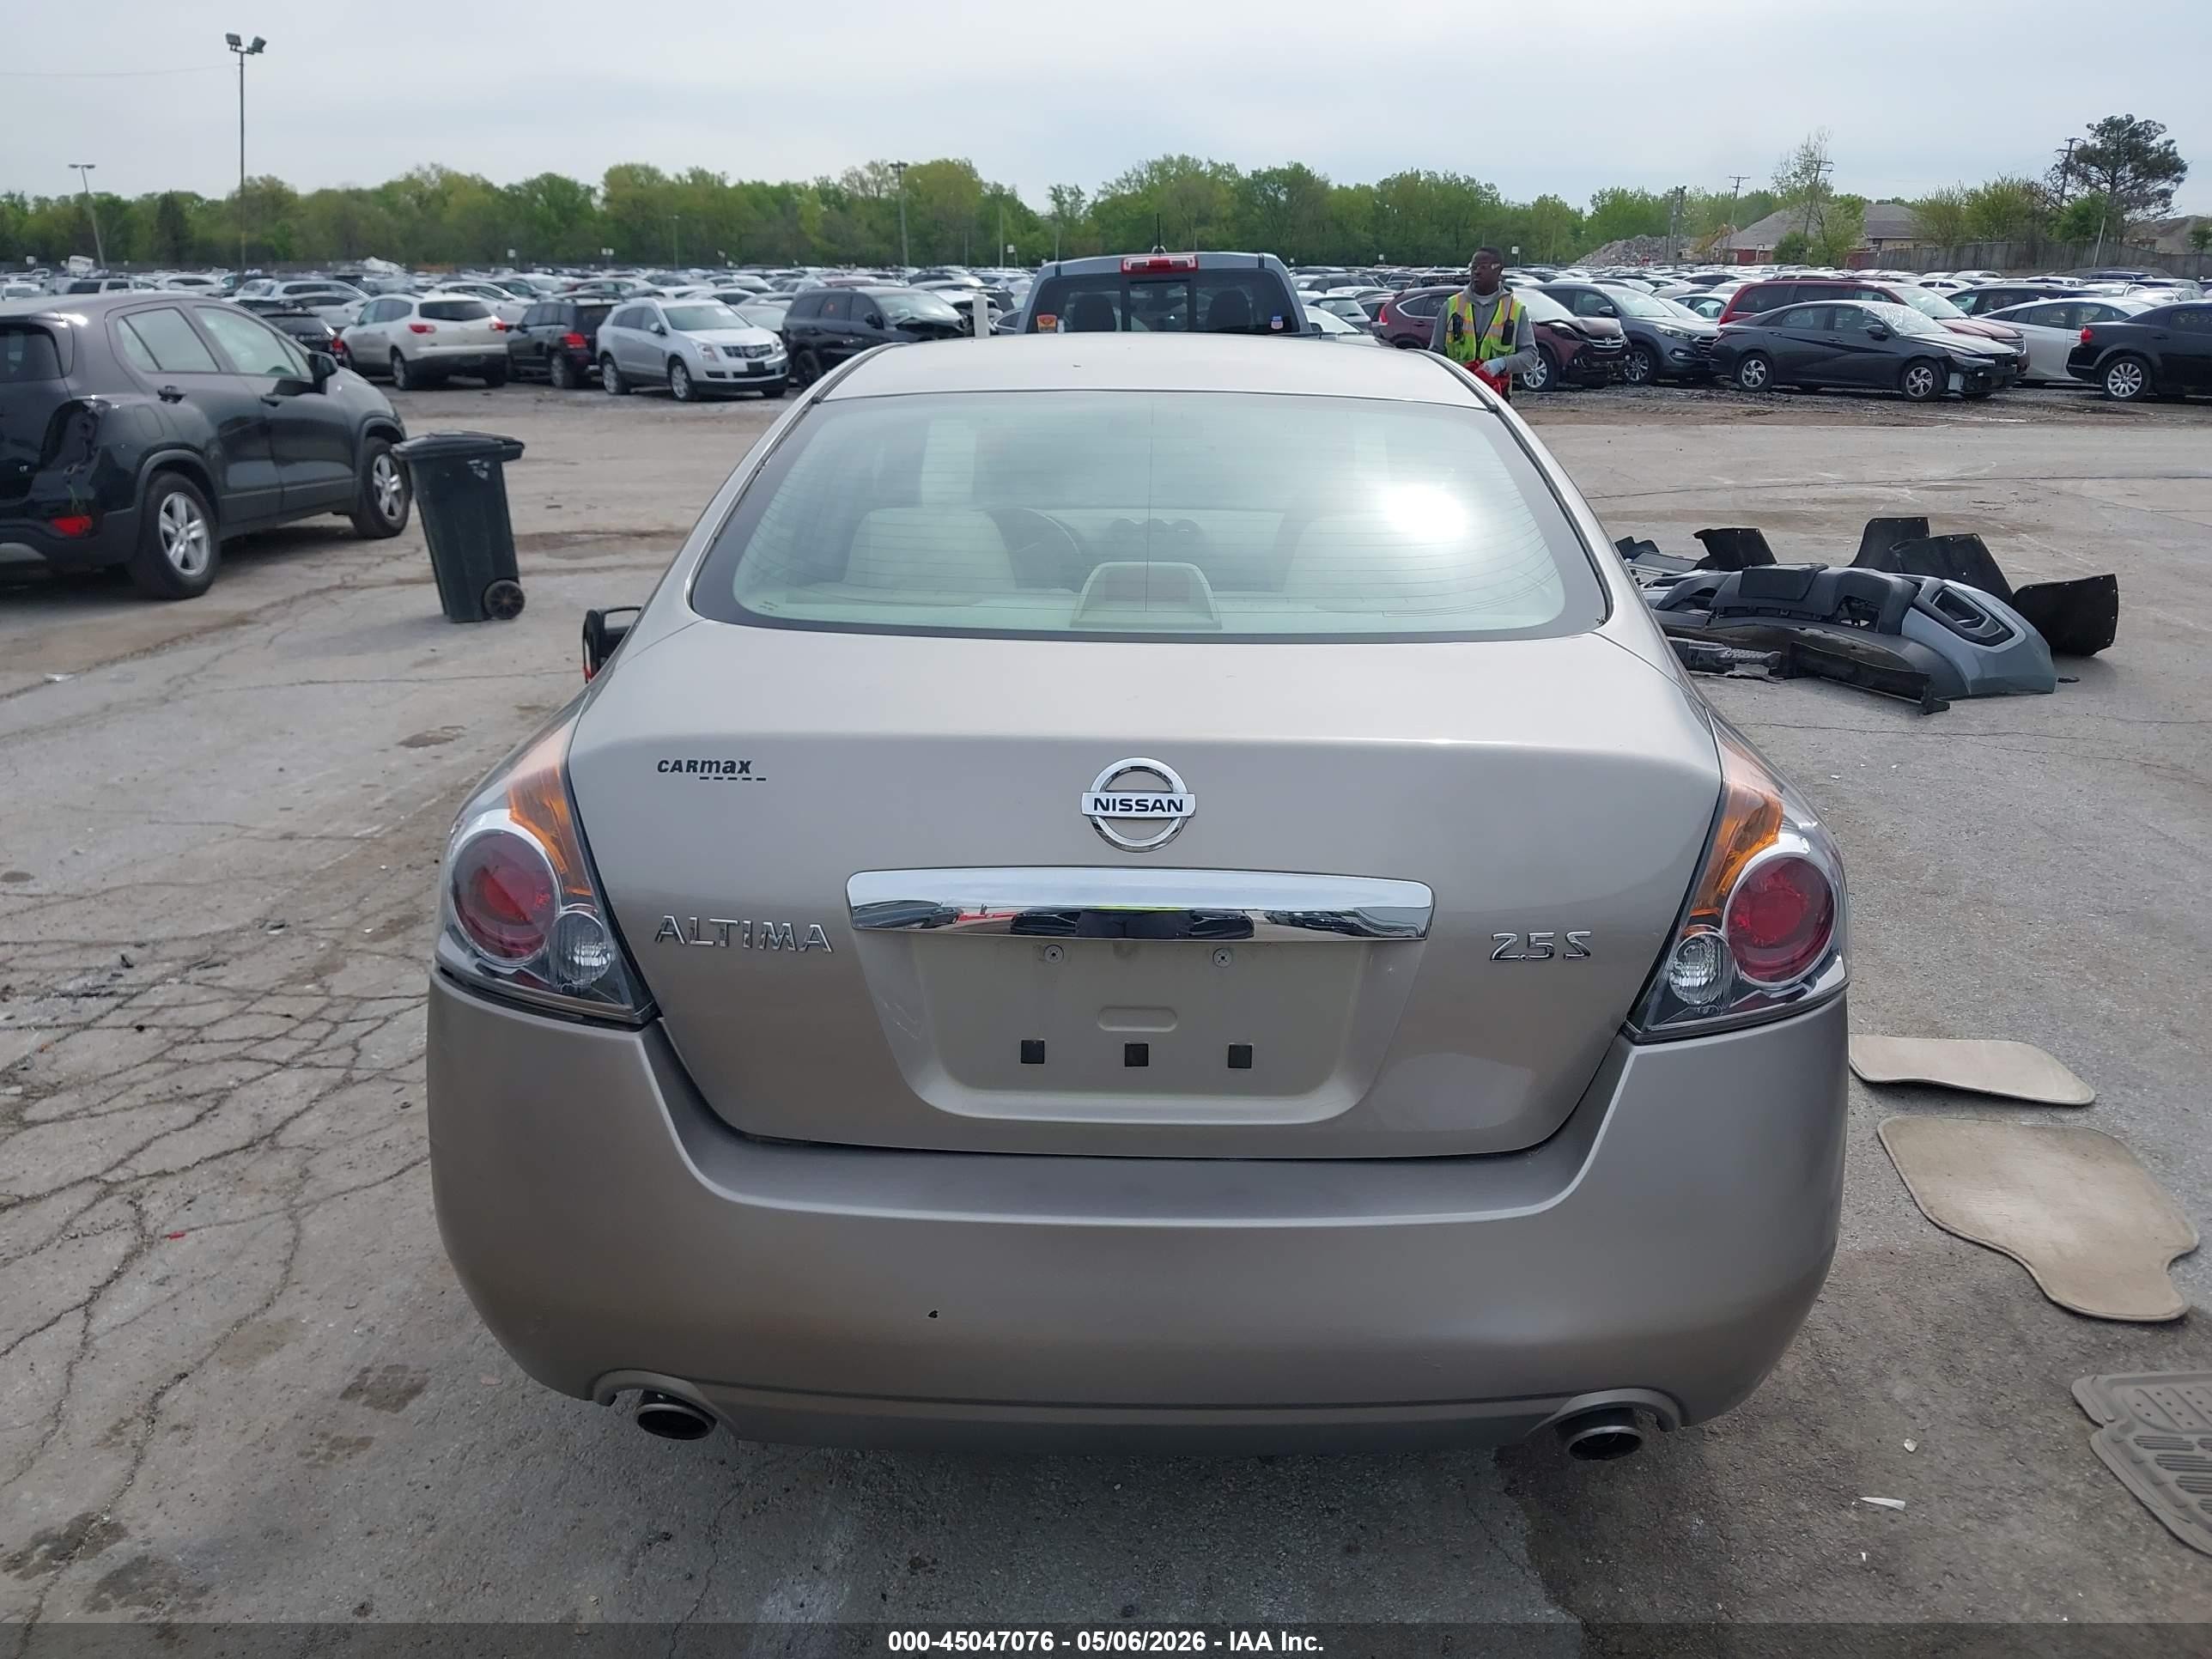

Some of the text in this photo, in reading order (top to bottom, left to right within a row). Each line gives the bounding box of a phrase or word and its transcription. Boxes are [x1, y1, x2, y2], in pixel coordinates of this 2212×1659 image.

[1093, 797, 1183, 812] NISSAN
[654, 915, 834, 953] ALTIMA
[1563, 931, 1592, 960] S
